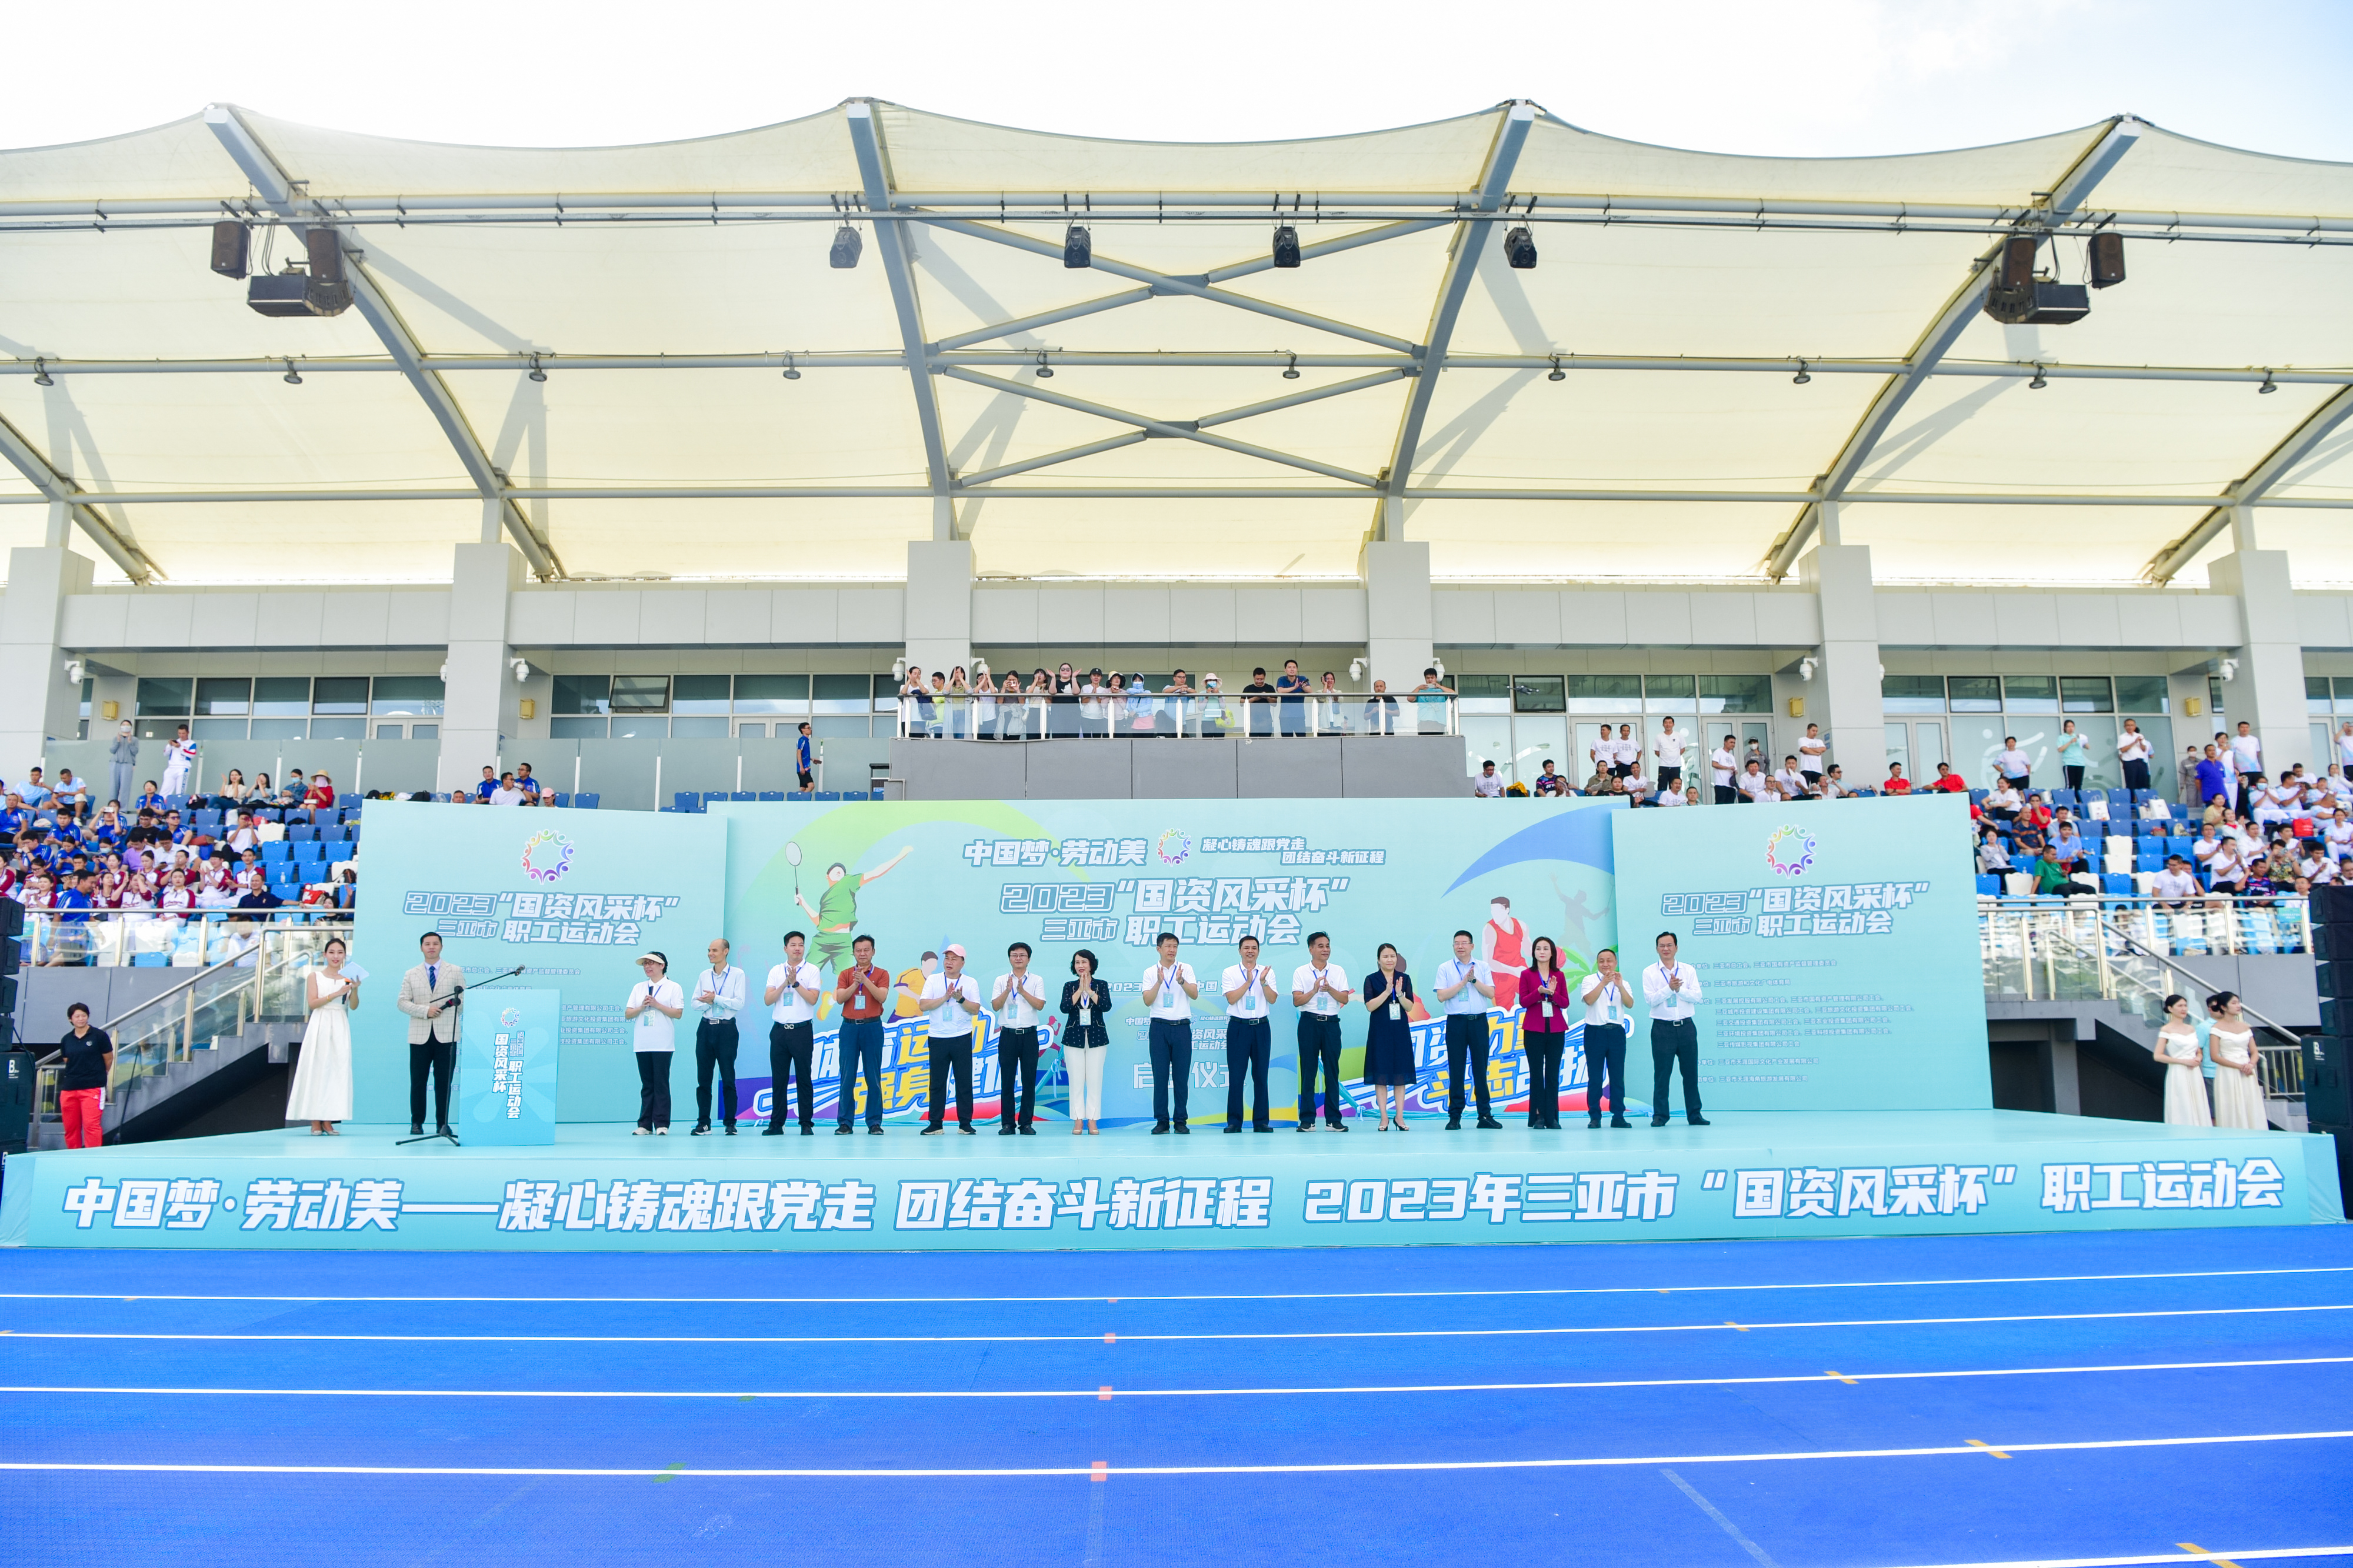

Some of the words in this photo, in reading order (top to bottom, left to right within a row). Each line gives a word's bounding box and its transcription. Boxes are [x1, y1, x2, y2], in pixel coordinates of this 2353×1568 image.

[964, 839, 1148, 868] 中国梦·劳动美
[1201, 836, 1306, 852] 凝心铸魂跟党走
[1280, 849, 1386, 866] 团结奋斗新征程
[435, 919, 499, 939] 三亚市
[503, 920, 642, 946] 职工运动会
[1040, 917, 1119, 942] 三亚市
[1124, 913, 1302, 946] 职工运动会
[1692, 916, 1751, 936] 三亚市
[1755, 910, 1892, 938] 职工运动会
[492, 1033, 509, 1093] 国资风采杯
[506, 1060, 524, 1119] 职工运动会
[894, 1177, 1272, 1232] 团结奋斗新征程
